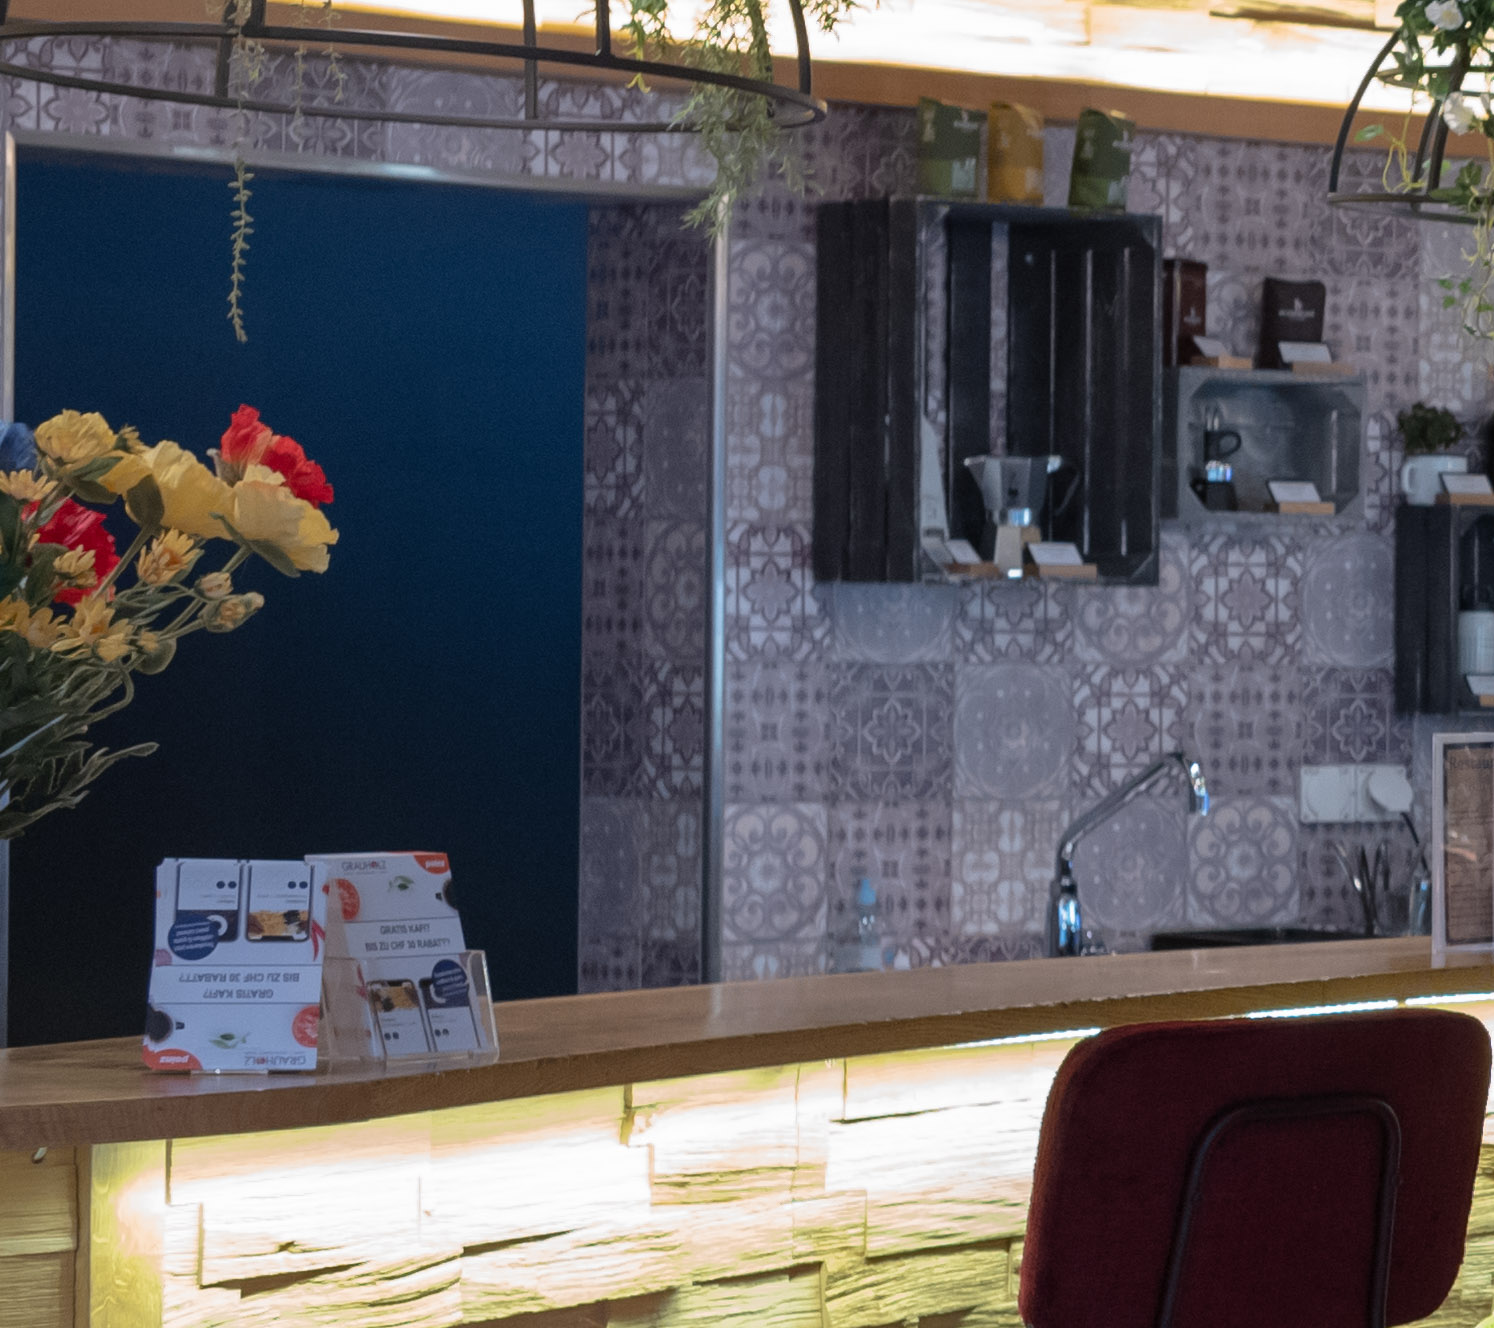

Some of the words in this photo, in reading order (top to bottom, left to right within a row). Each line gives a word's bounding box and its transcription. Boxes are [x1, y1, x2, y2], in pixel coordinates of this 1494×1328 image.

[380, 924, 408, 935] GRATIS
[178, 972, 227, 983] RABATT?
[243, 972, 265, 983] CHF
[266, 972, 281, 983] ZU
[282, 972, 300, 983] BIS
[235, 988, 274, 999] GRATIS
